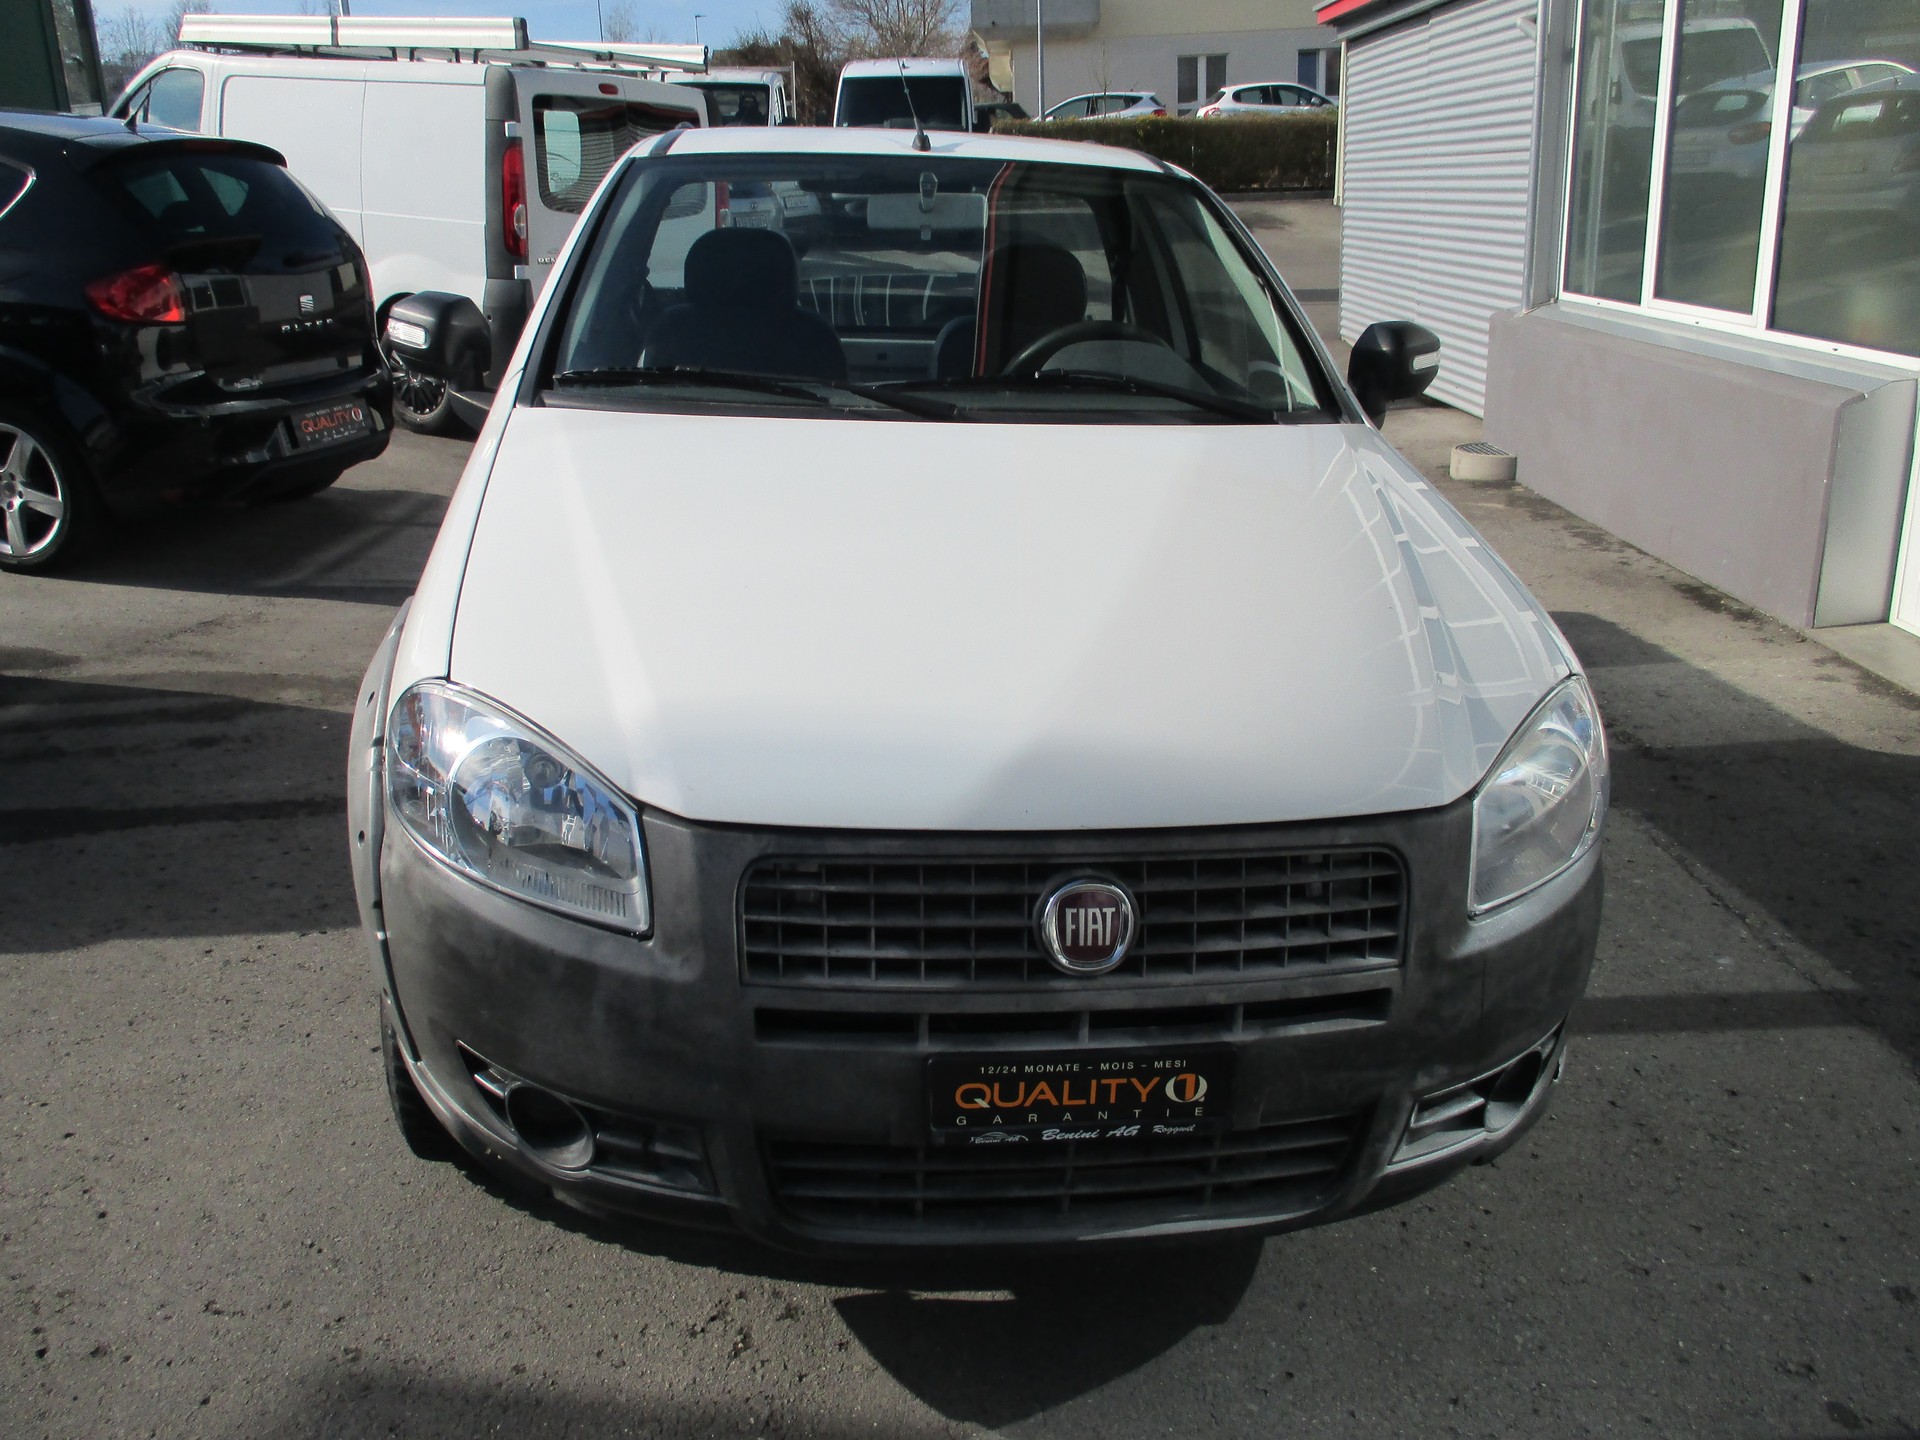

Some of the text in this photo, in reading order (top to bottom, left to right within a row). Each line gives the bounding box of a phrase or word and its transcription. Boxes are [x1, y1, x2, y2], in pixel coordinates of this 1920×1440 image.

[302, 410, 350, 433] QUALITY
[1065, 907, 1116, 946] FIAT
[980, 1065, 1017, 1075] 12/24
[1024, 1063, 1080, 1073] MONATE
[1100, 1061, 1134, 1071] MOIS
[1154, 1059, 1187, 1069] MESI
[955, 1076, 1161, 1109] QUALITY
[956, 1106, 1204, 1126] GARANTIE
[1041, 1123, 1196, 1141] Benini AG Roggwil
